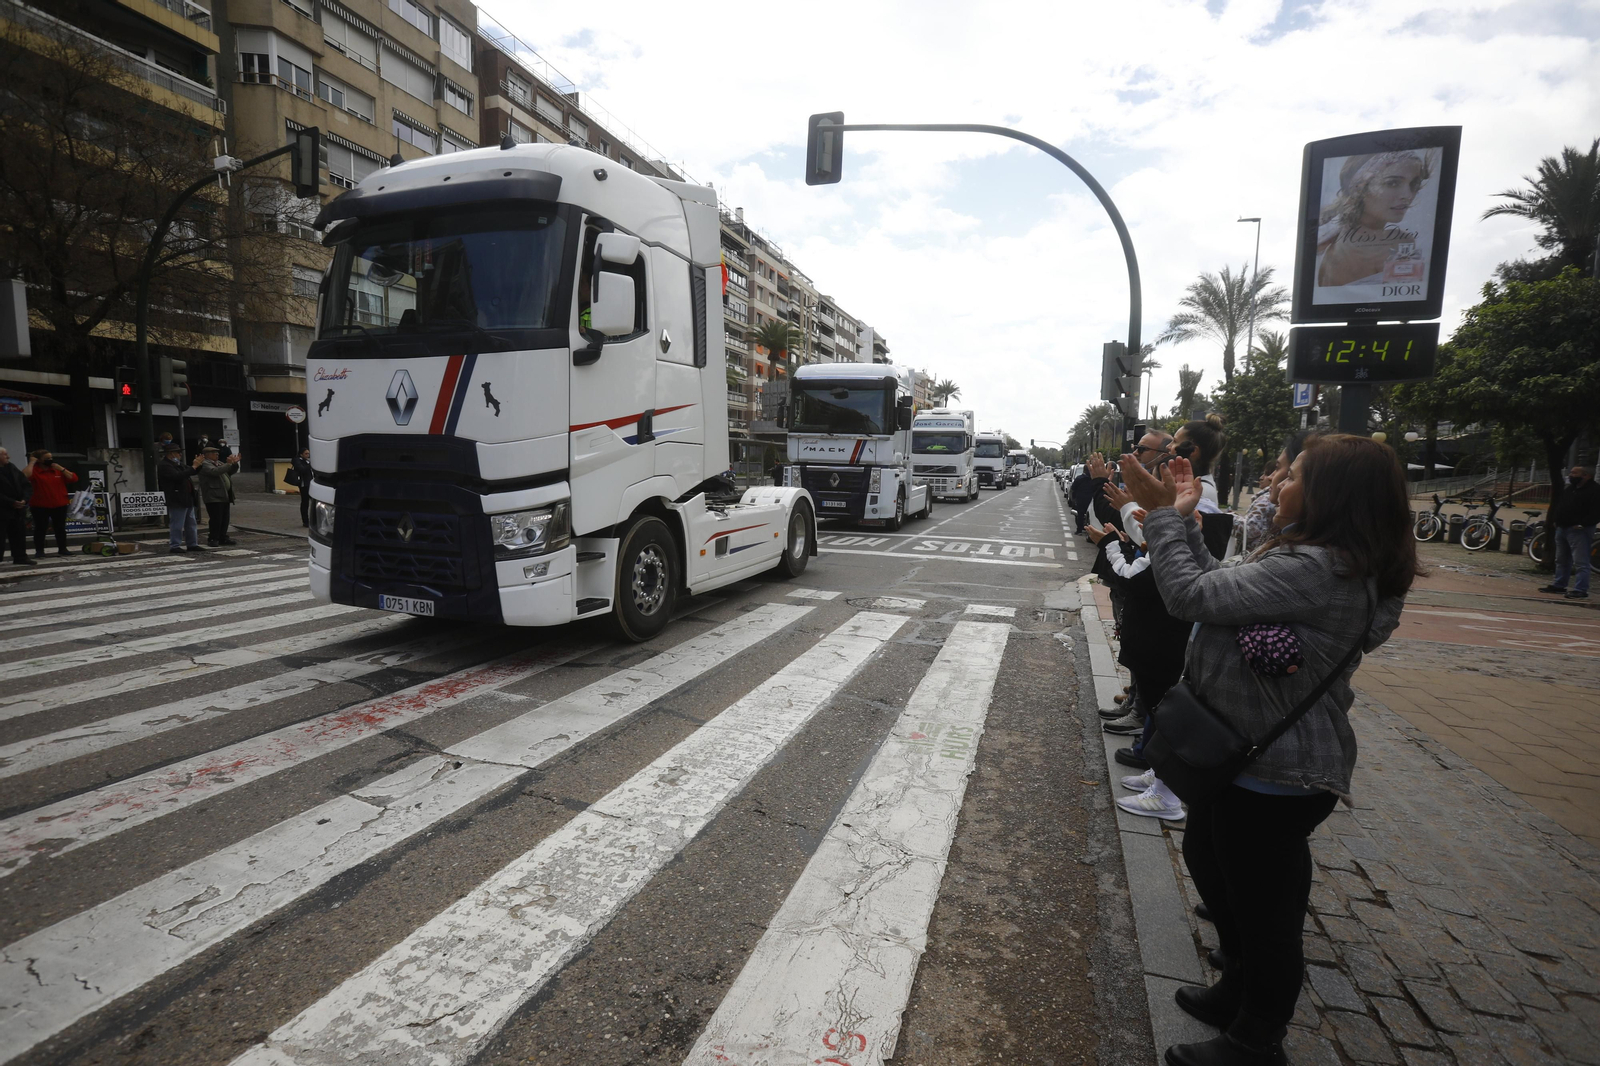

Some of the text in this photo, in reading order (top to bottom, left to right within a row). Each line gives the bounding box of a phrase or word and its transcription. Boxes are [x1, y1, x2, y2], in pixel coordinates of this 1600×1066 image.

[1335, 224, 1419, 243] Miss Dior
[1382, 285, 1421, 297] DIOR
[1325, 340, 1413, 363] 12:41
[123, 495, 165, 504] CORDOBA
[912, 540, 1055, 559] MOTOS
[385, 597, 433, 614] 0751 KBN
